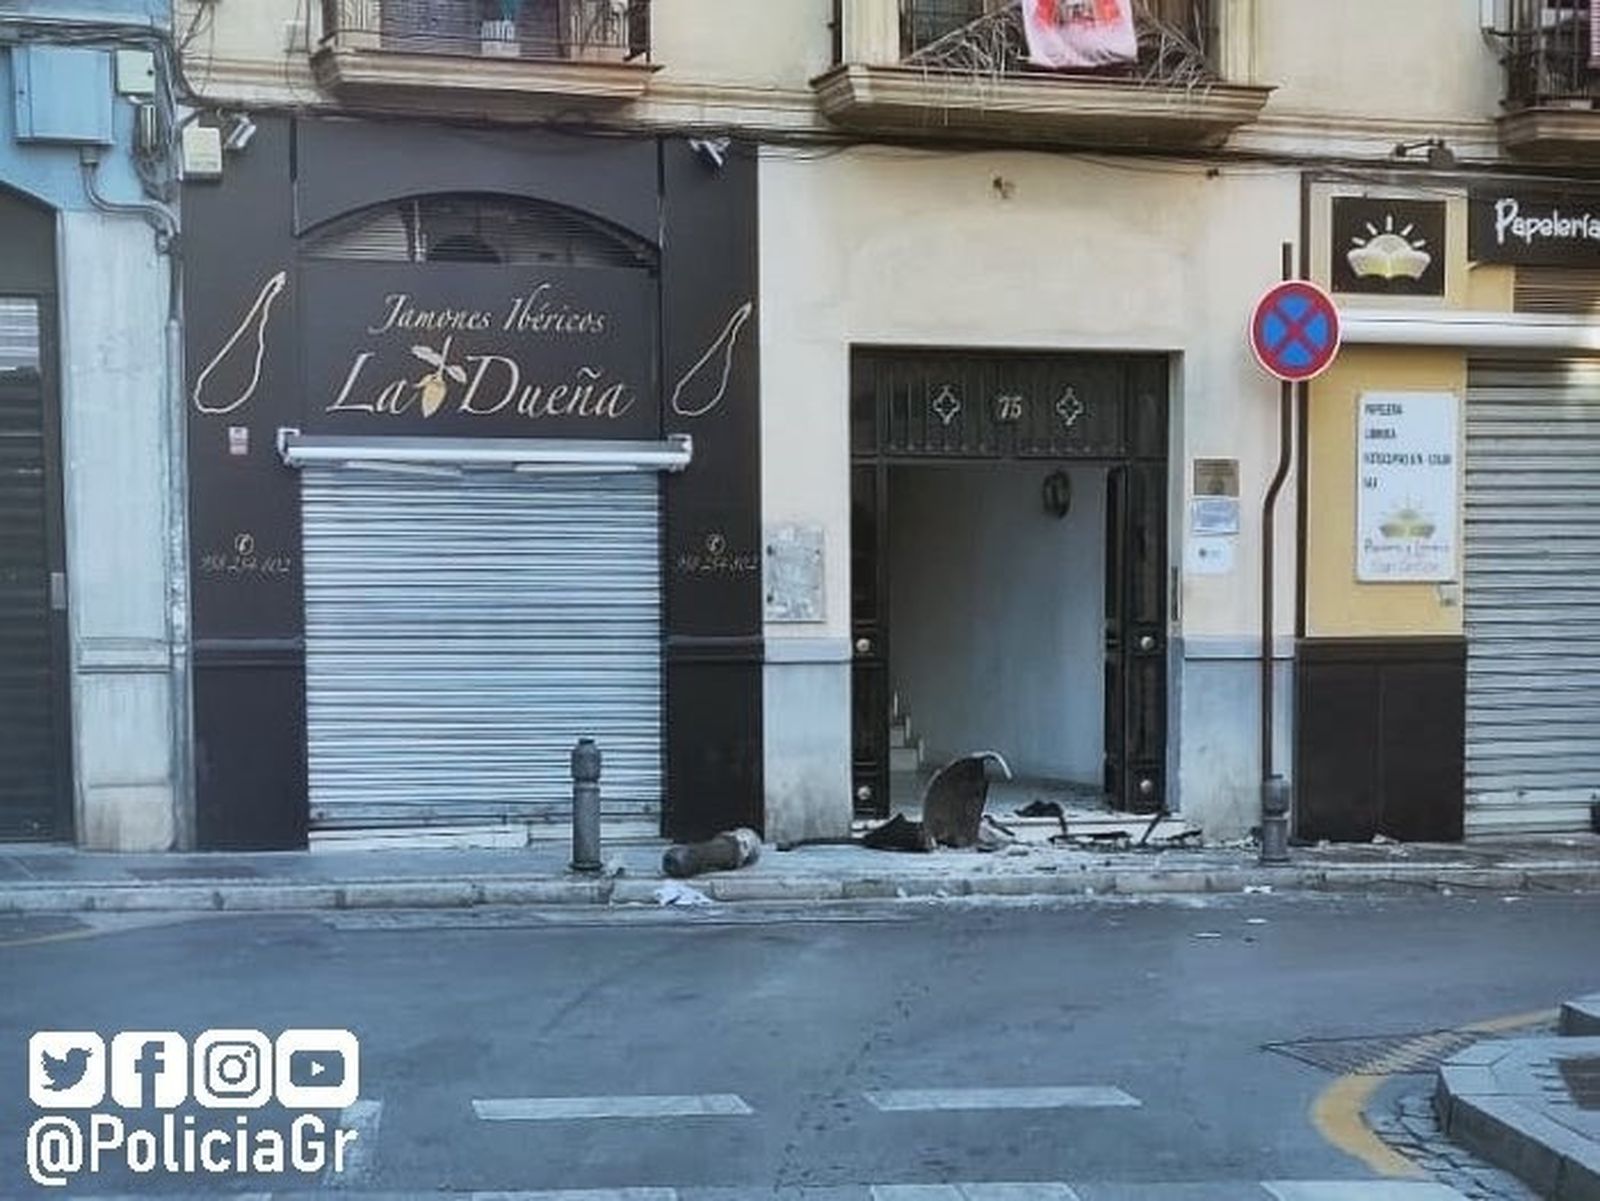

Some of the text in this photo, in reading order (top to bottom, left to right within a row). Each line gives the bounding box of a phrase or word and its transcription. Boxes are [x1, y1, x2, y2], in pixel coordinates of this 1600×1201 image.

[367, 294, 492, 334] Jamones
[326, 352, 635, 418] La Dueña
[998, 396, 1022, 419] 75
